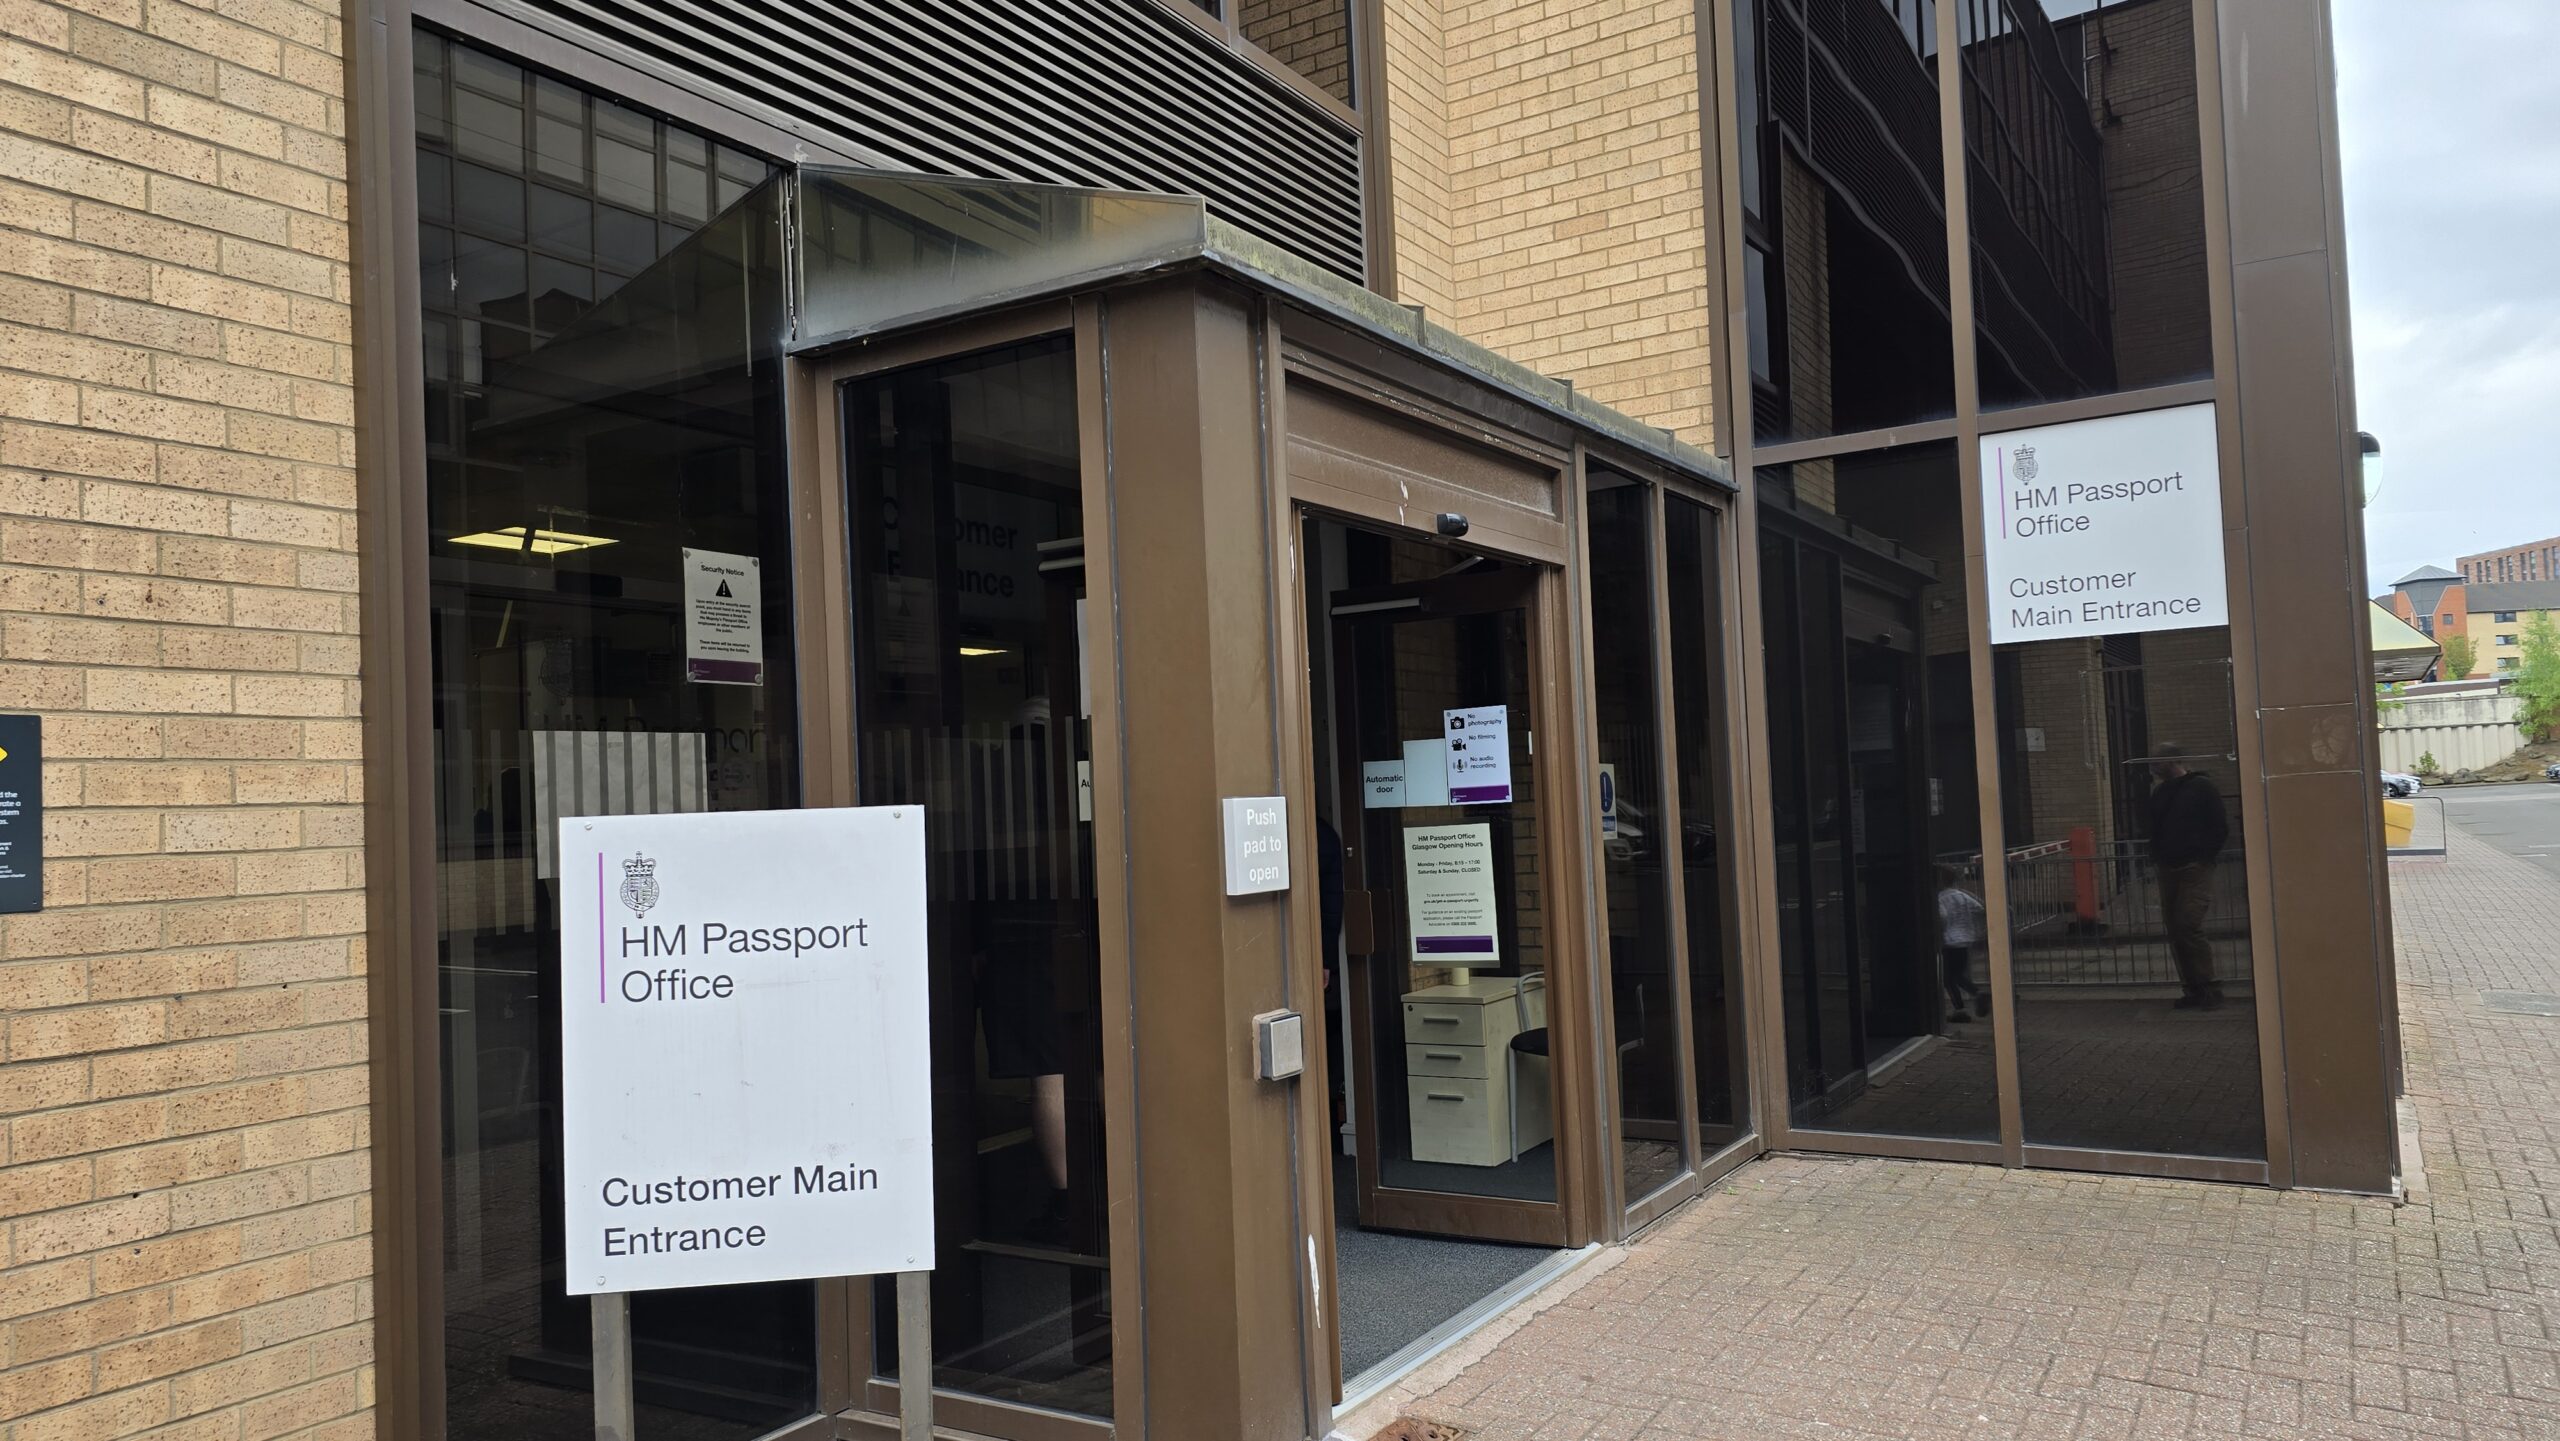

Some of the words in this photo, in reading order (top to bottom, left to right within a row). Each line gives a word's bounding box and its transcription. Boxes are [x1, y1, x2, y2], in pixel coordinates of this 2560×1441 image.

[2015, 486, 2058, 510] HM
[2067, 471, 2184, 504] Passport
[2016, 513, 2091, 538] Office
[701, 564, 725, 575] Security
[725, 568, 744, 576] Notice
[2009, 571, 2137, 598] Customer
[2011, 605, 2073, 629] Main
[2082, 596, 2202, 622] Entrance
[1467, 718, 1502, 727] photography
[1365, 774, 1404, 783] Automatic
[1376, 785, 1395, 793] door
[1246, 808, 1277, 826] Push
[1243, 836, 1267, 858] pad
[1269, 836, 1282, 852] to
[1438, 842, 1464, 850] Opening
[1248, 866, 1279, 885] open
[621, 923, 687, 958] HM
[702, 917, 869, 958] Passport
[620, 969, 734, 1003] Office
[602, 1173, 782, 1208] Customer
[793, 1162, 879, 1197] Main
[603, 1223, 767, 1258] Entrance
